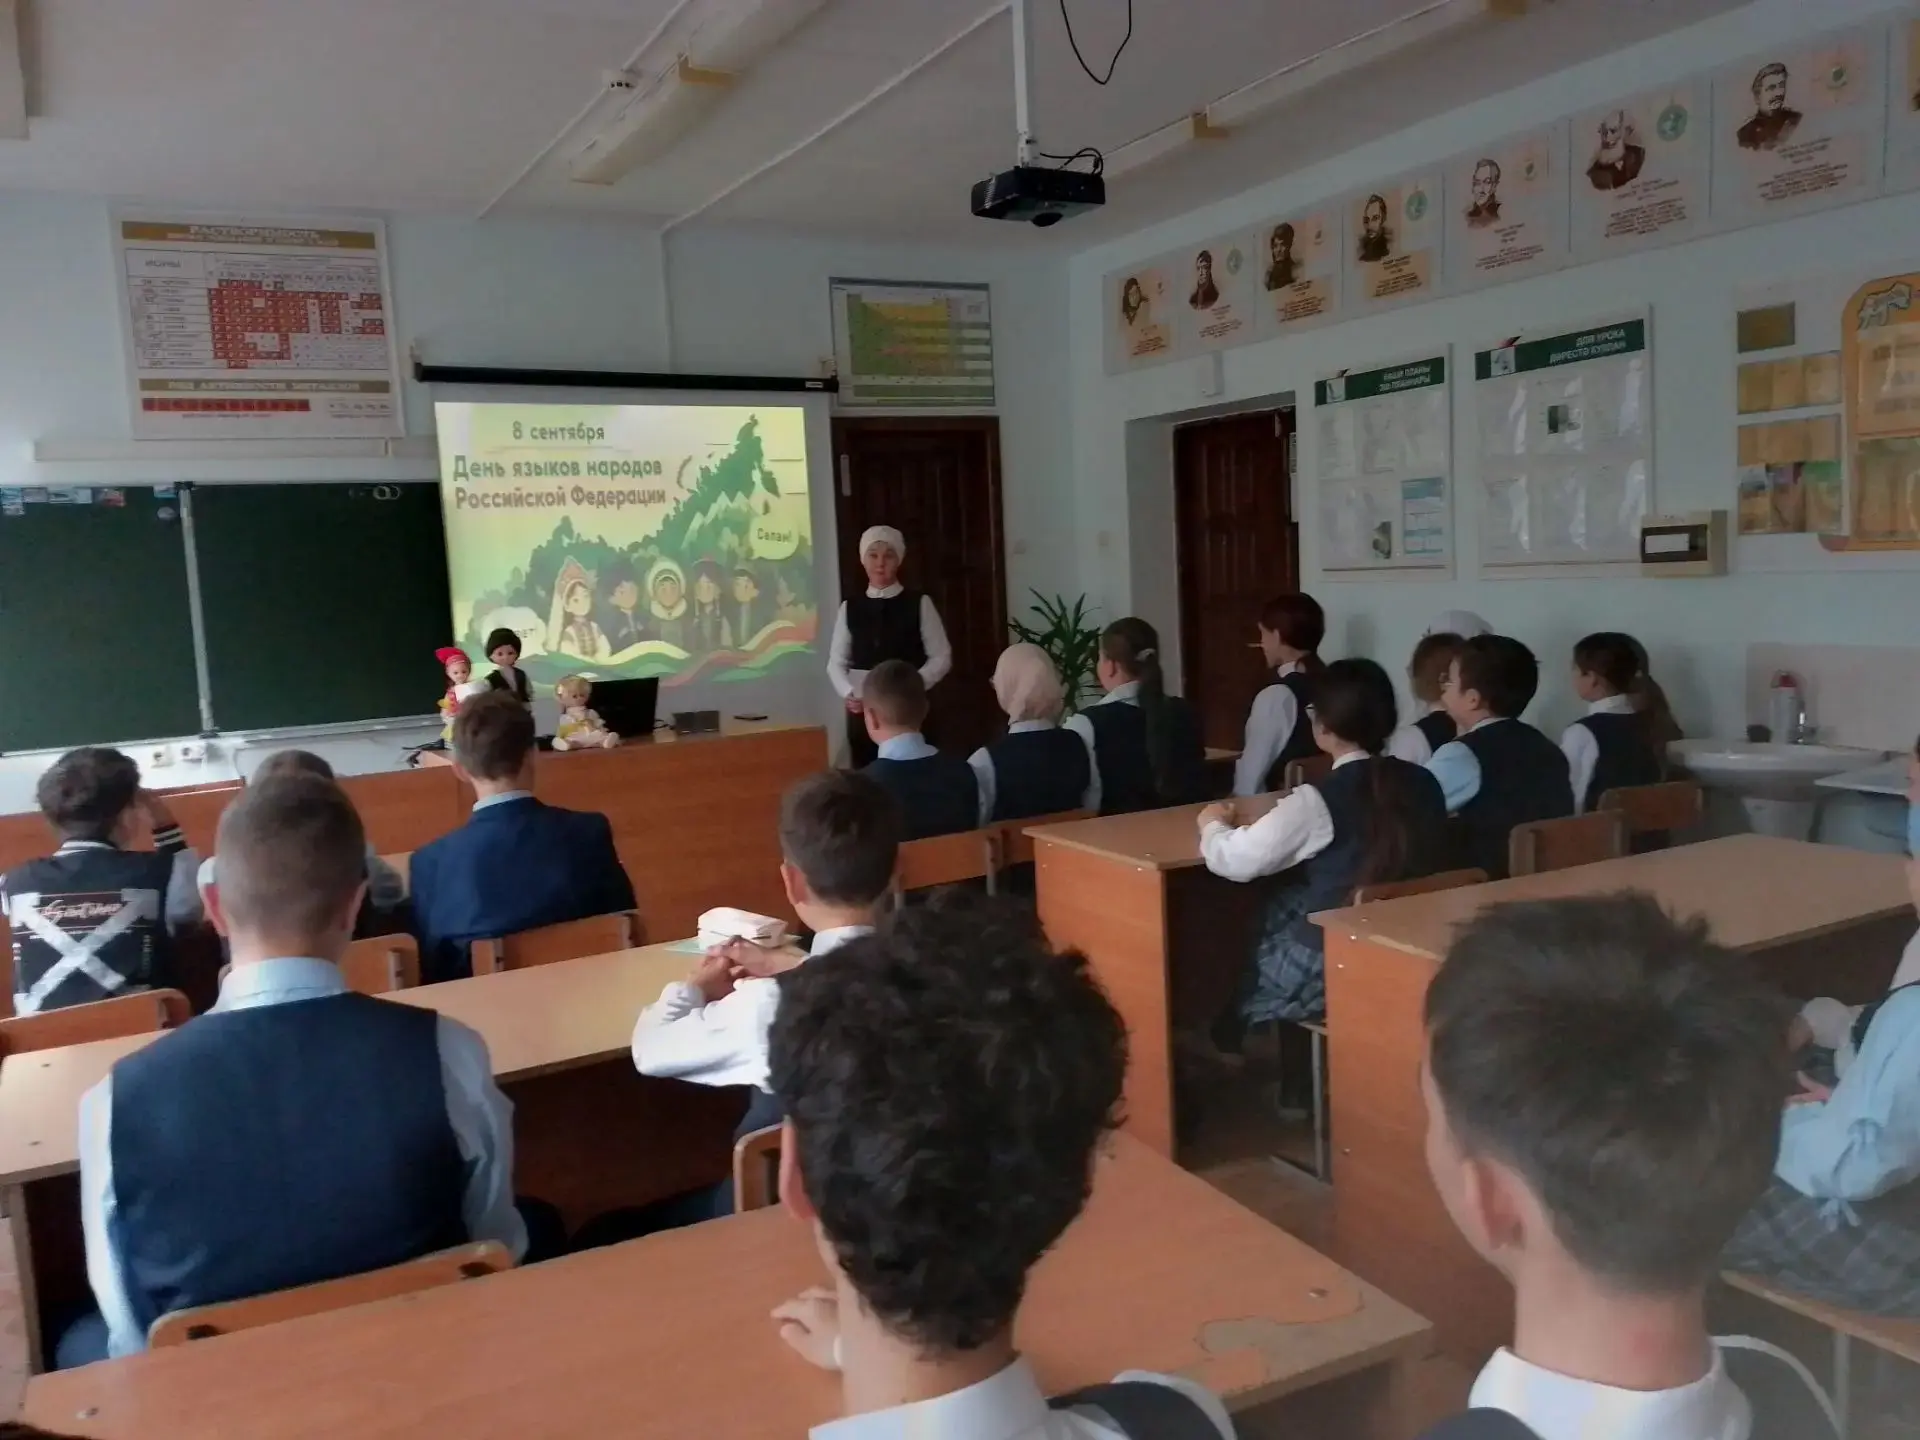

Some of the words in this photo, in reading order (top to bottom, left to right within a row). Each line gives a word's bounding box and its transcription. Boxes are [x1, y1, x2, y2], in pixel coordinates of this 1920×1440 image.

[512, 420, 523, 440] 8
[530, 422, 605, 444] сентября
[453, 455, 506, 481] День
[512, 460, 580, 477] языков
[587, 460, 662, 480] народов
[455, 485, 566, 509] Российской
[571, 485, 666, 508] Федерации
